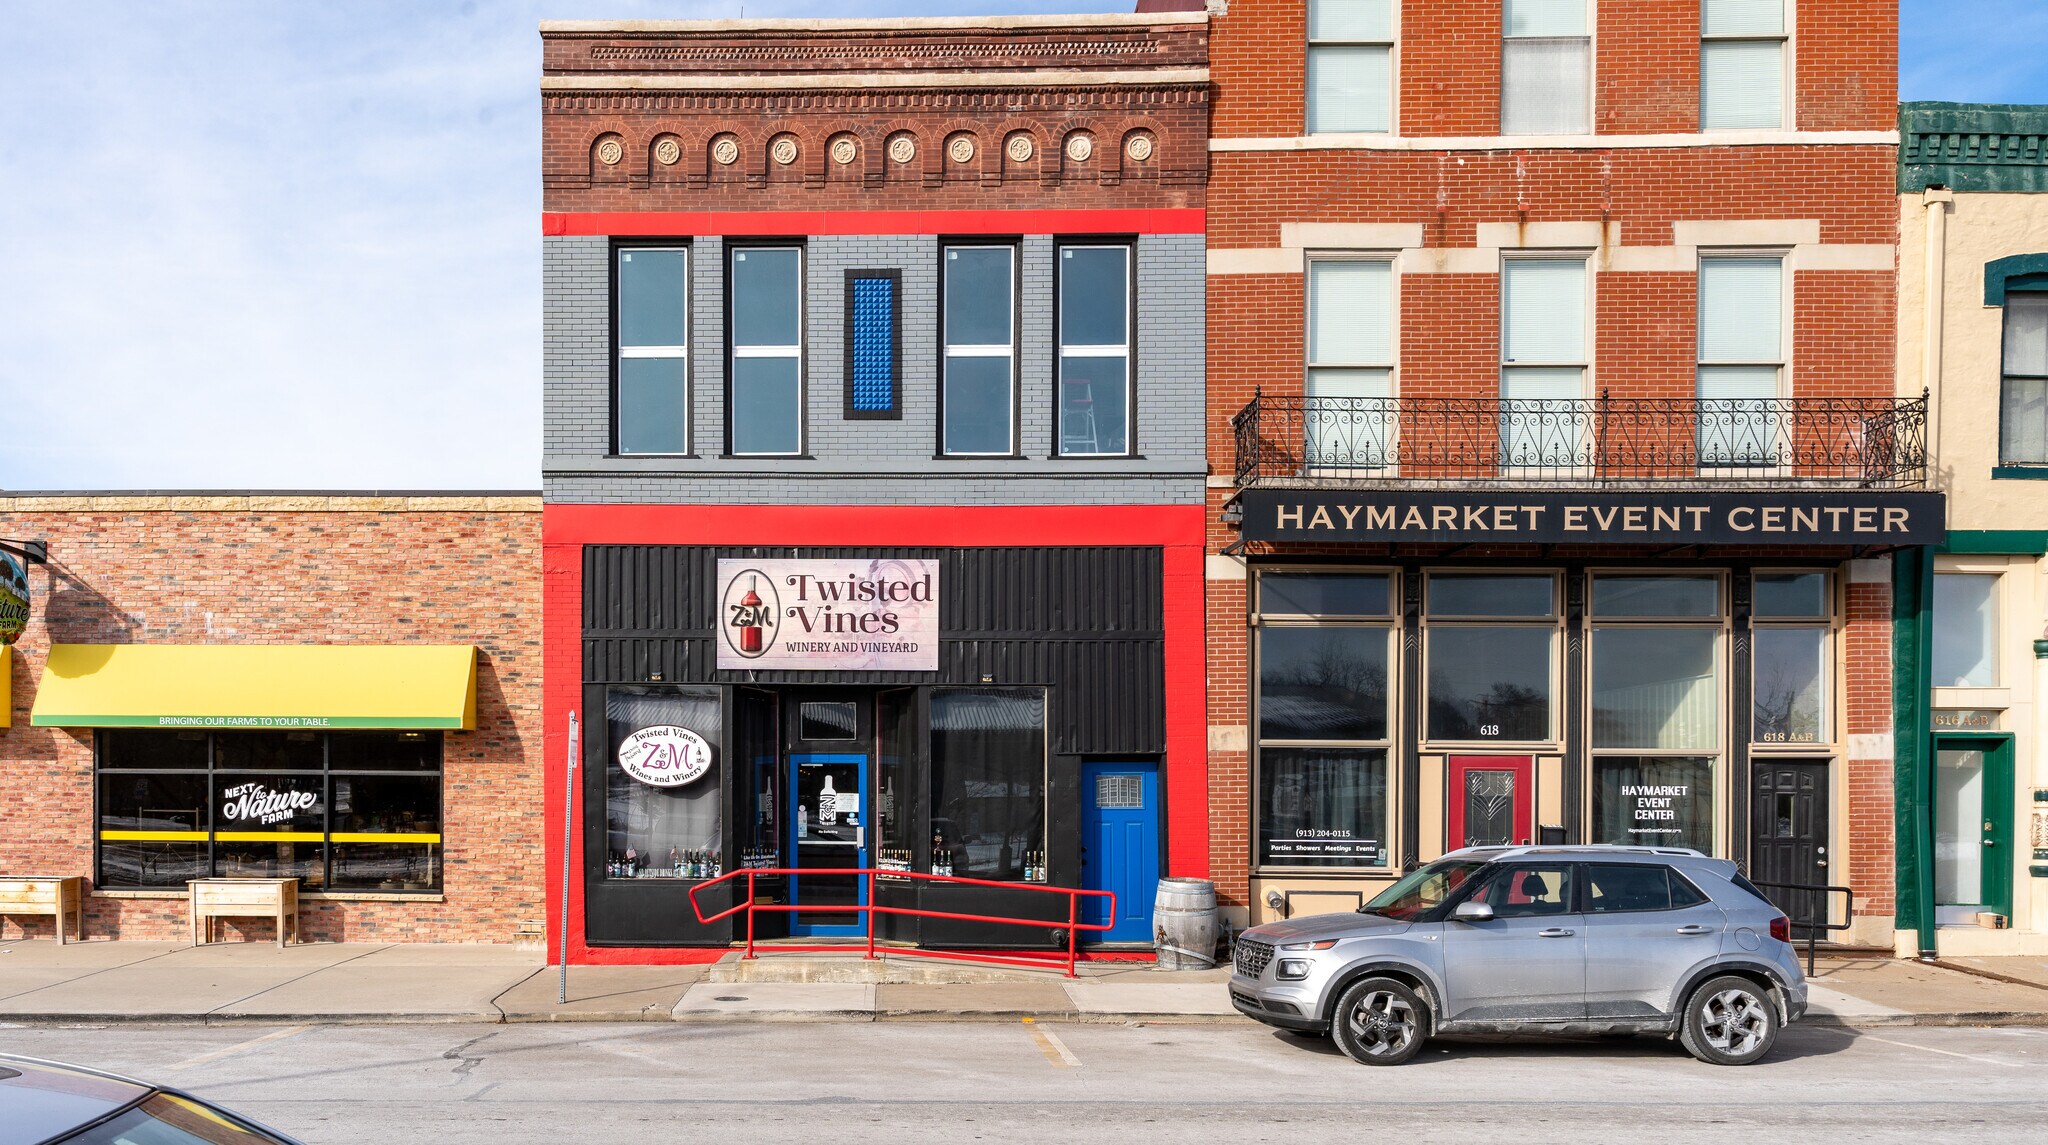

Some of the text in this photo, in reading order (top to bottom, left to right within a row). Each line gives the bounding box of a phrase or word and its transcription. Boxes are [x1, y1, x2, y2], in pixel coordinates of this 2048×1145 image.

[1276, 505, 1910, 532] HAYMARKET EVENT CENTER
[786, 573, 934, 602] Twisted
[0, 598, 30, 621] ture
[786, 605, 900, 634] Vines
[786, 642, 919, 653] WINERY AND VINEYARD
[159, 717, 331, 726] BRINGING OUR FARMS TO YOUR TABLE.
[1935, 715, 1989, 726] 616 A&B
[1480, 724, 1499, 735] 618
[631, 728, 697, 744] Twisted Vines
[1763, 732, 1813, 742] 618 A&B
[642, 742, 693, 770] Z&M
[629, 763, 702, 783] Wines and Winery
[224, 783, 256, 799] NEXT
[255, 790, 267, 800] to
[1621, 785, 1688, 796] HAYMARKET
[223, 789, 318, 821] Nature
[1637, 797, 1672, 808] EVENT
[261, 808, 294, 825] FARM
[1634, 809, 1675, 820] CENTER
[1295, 828, 1351, 838] (913) 204-0115
[1324, 845, 1352, 854] Meetings
[1355, 845, 1376, 853] Events
